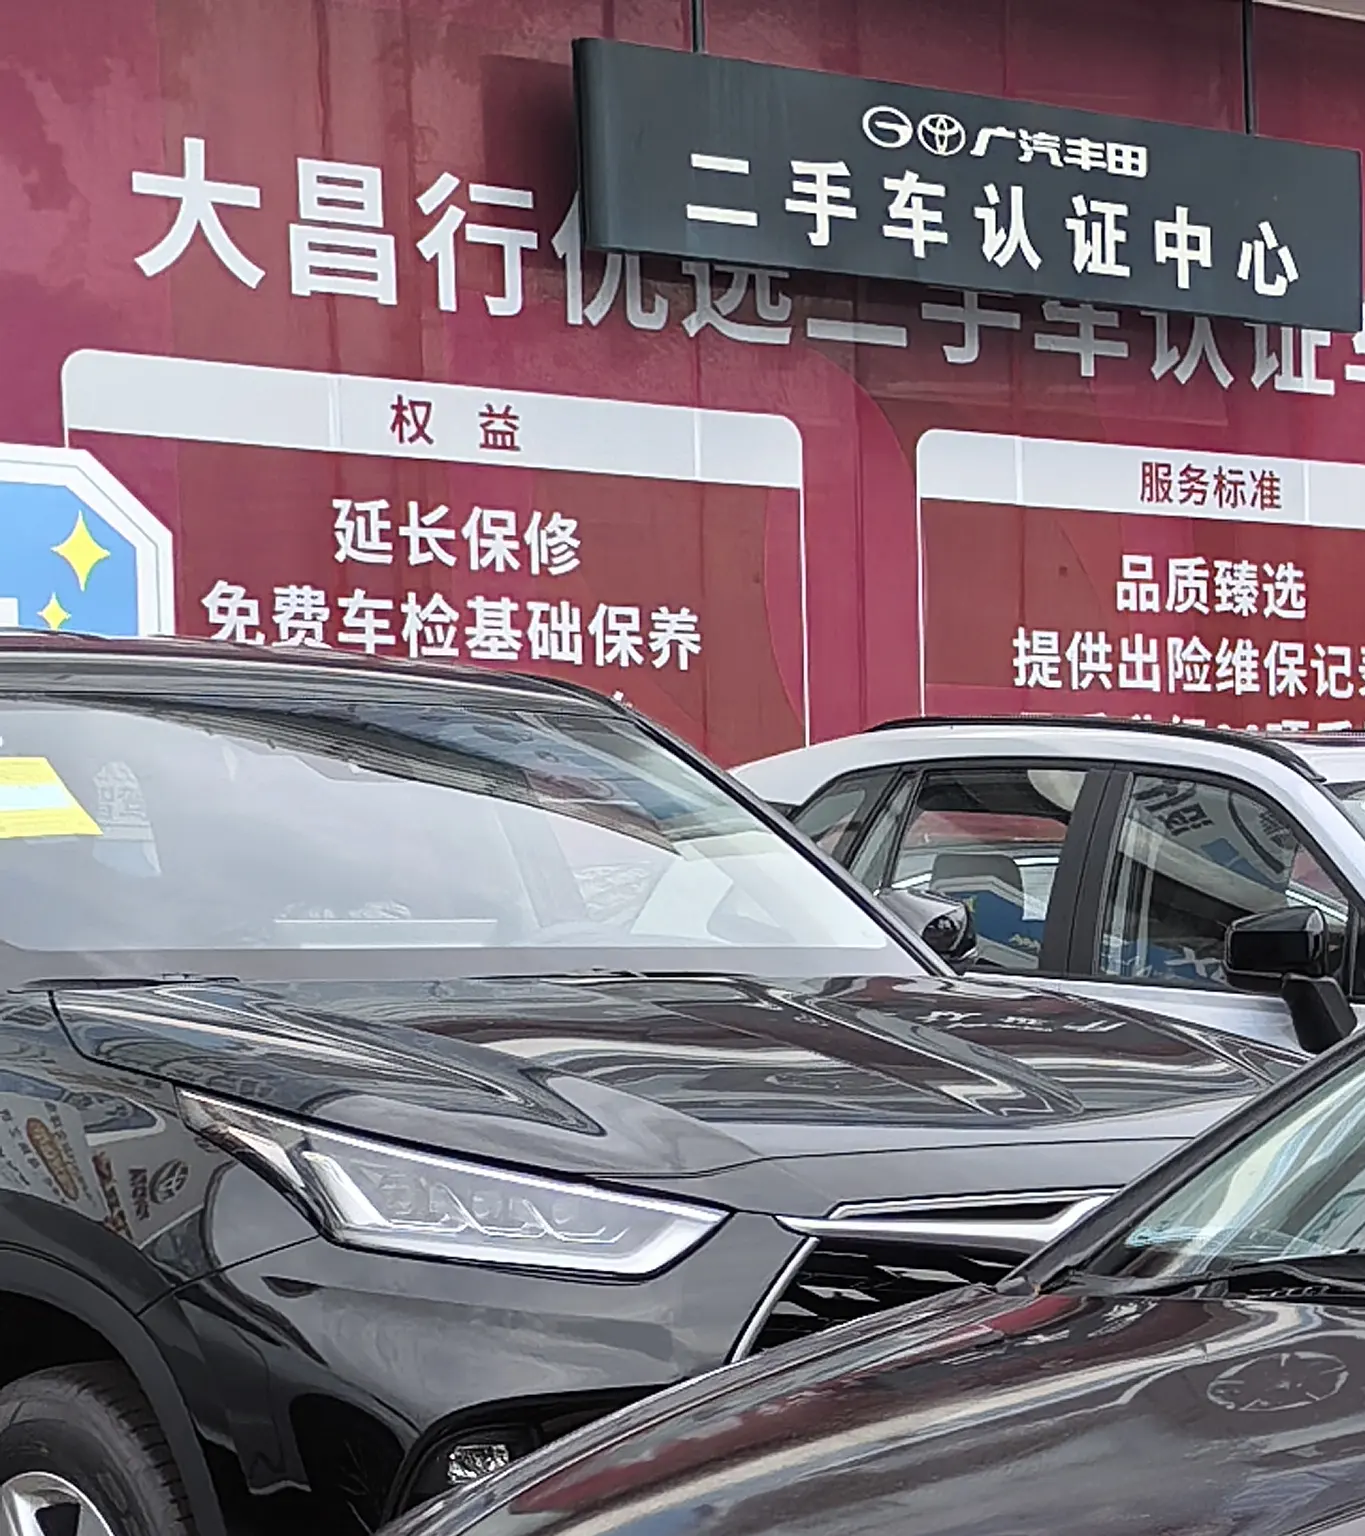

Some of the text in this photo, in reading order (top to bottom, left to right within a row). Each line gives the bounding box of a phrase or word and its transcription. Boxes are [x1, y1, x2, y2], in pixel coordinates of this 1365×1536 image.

[969, 125, 1147, 178] 广汽丰田
[686, 152, 1300, 297] 二手车认证中心
[389, 393, 522, 452] 权益
[1139, 460, 1283, 511] 服务标准
[332, 498, 581, 576] 延长保修
[1115, 553, 1307, 619] 品质臻选
[200, 579, 702, 672] 免费车检基础保养
